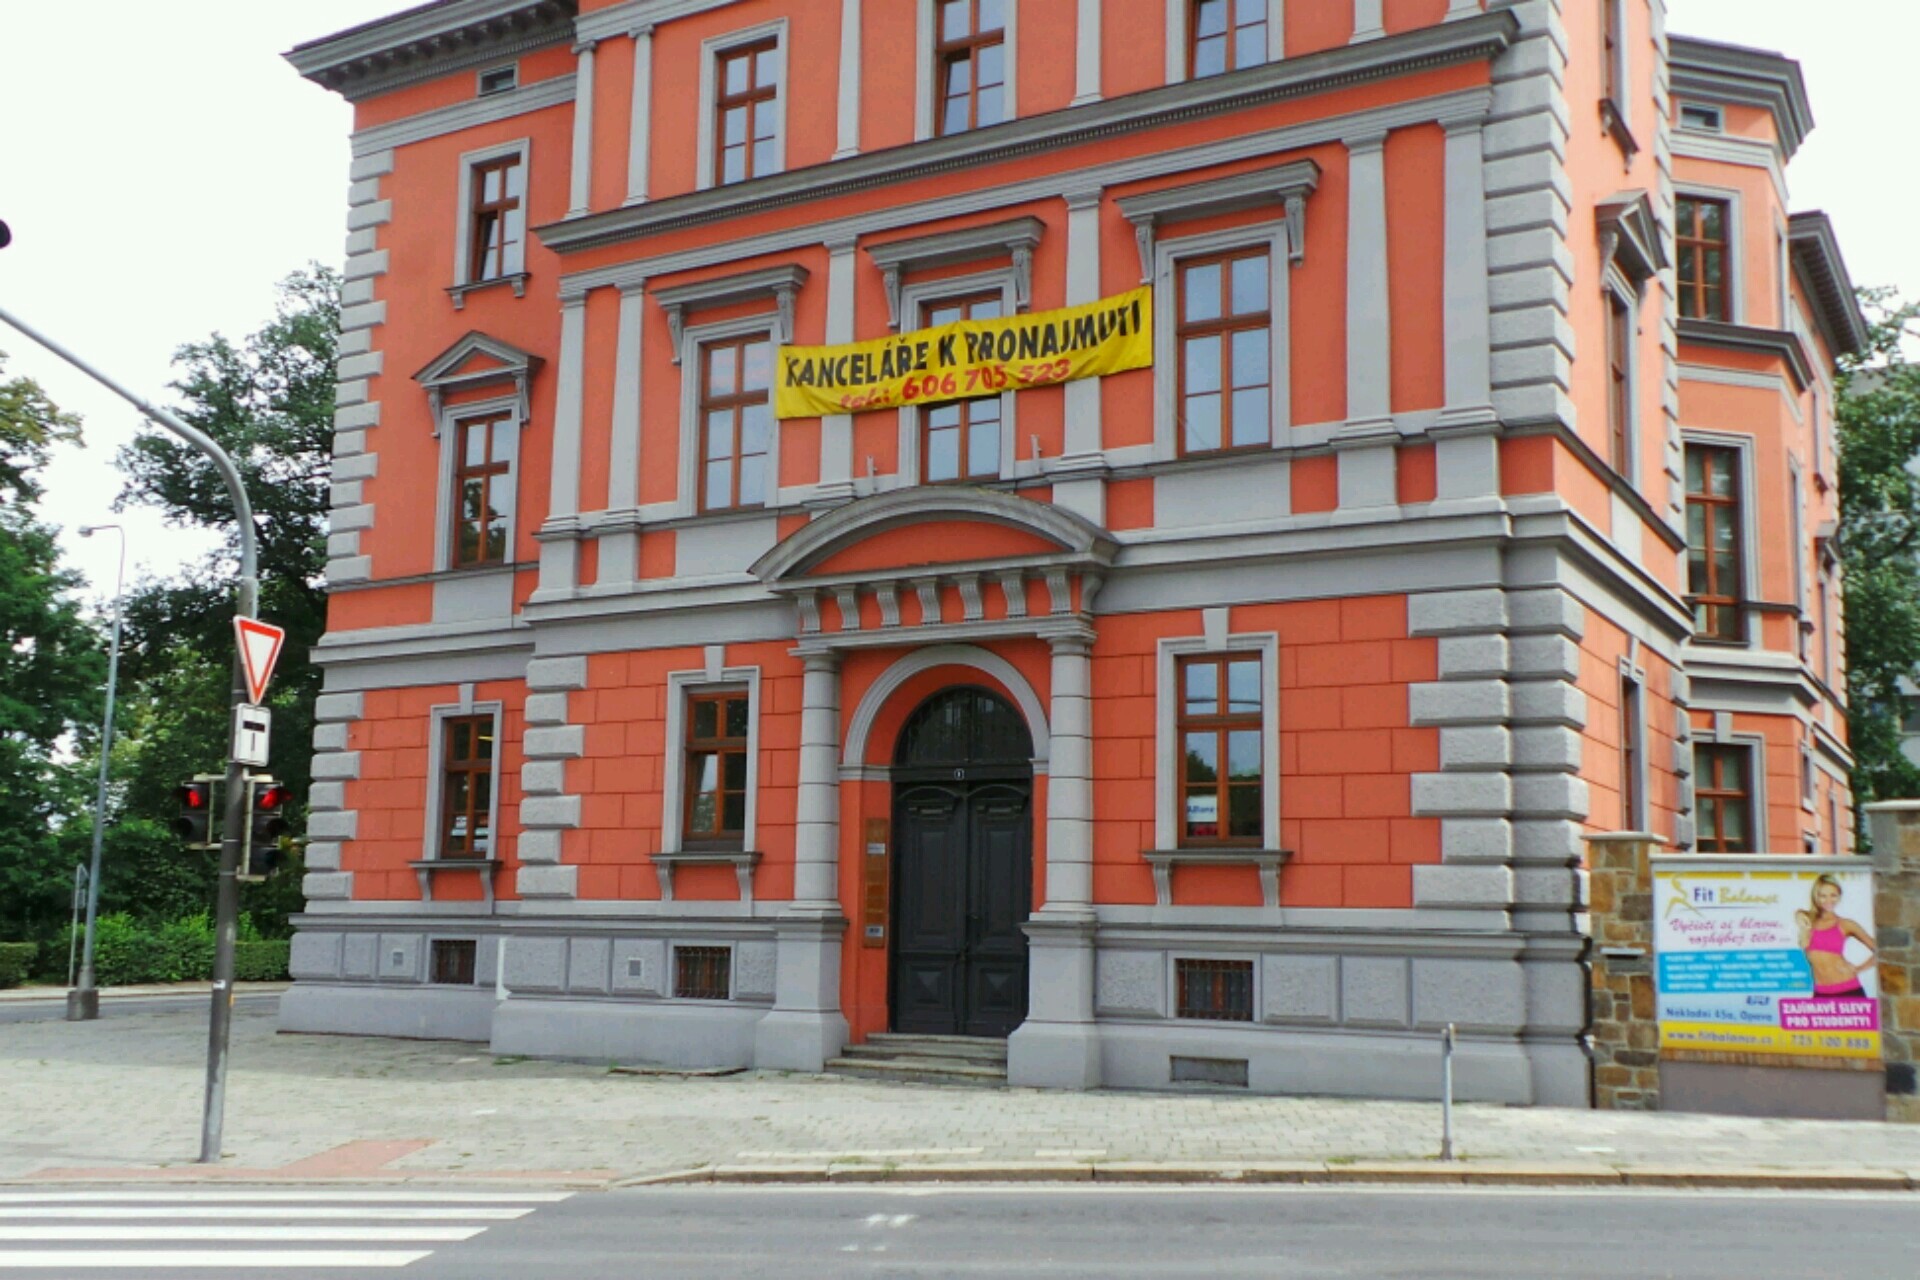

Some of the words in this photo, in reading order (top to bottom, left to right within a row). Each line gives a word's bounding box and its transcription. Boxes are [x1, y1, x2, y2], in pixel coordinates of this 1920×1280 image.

[785, 336, 927, 388] KANCELÁŘE
[938, 333, 957, 367] K
[902, 374, 957, 401] 606
[966, 365, 1008, 393] 705
[1017, 359, 1071, 384] 523
[1693, 887, 1713, 902] Fit
[1719, 887, 1779, 904] Balance
[1839, 1003, 1872, 1014] SLEVY
[1740, 1011, 1772, 1021] Opava
[1787, 1016, 1809, 1027] PRO
